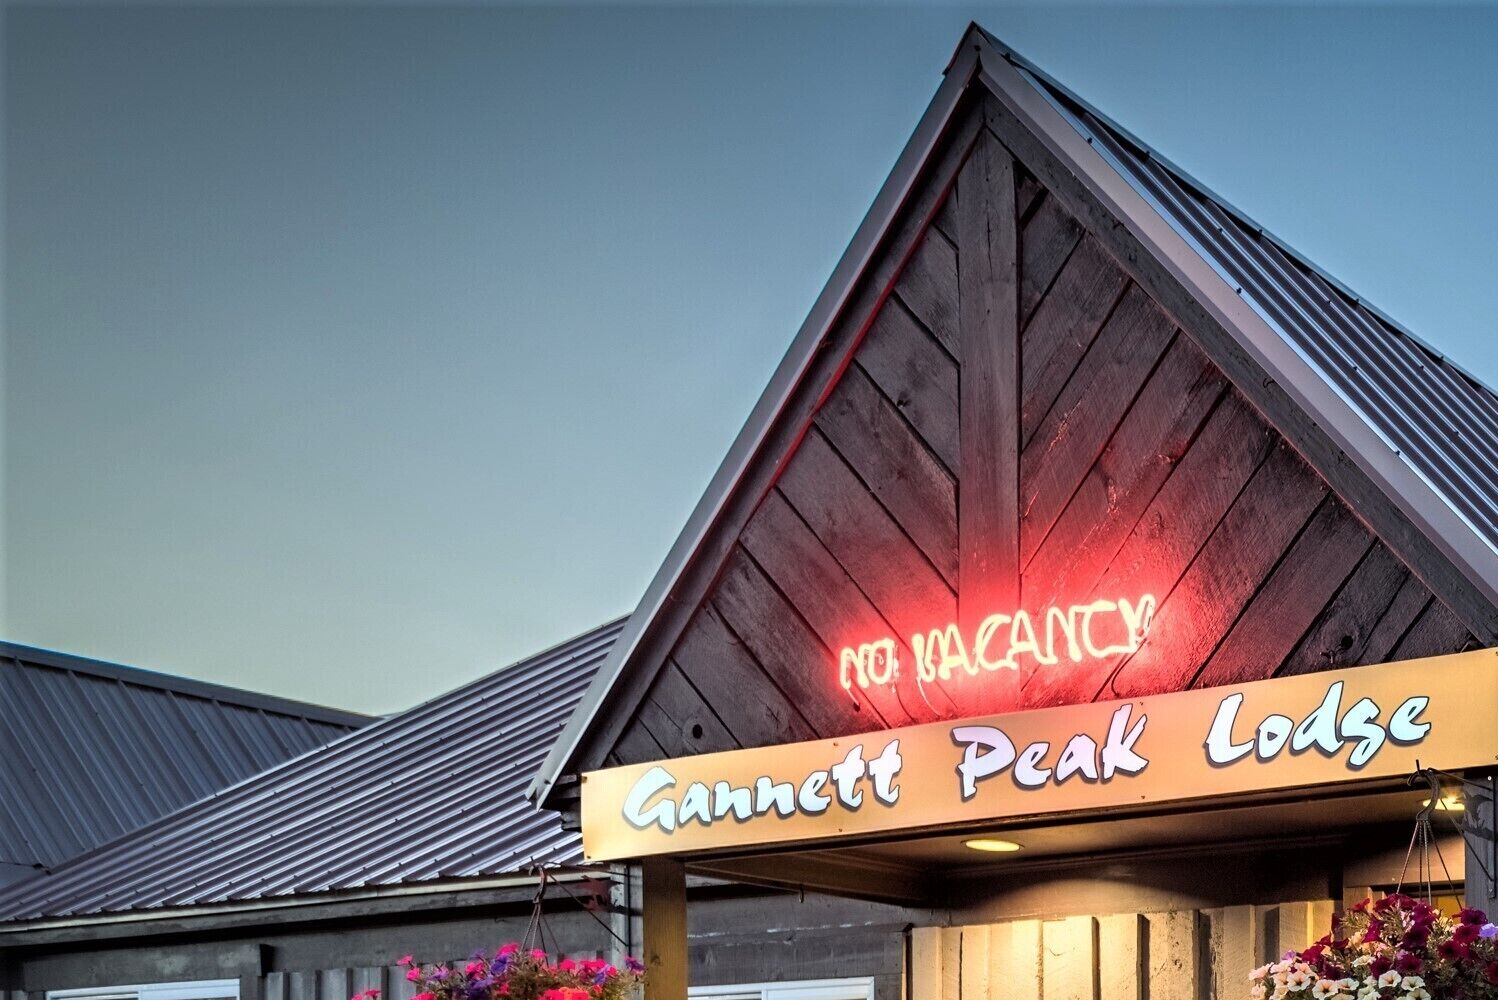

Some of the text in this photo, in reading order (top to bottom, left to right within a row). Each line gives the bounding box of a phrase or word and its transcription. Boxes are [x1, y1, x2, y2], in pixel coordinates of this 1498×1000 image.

[839, 593, 1157, 689] NO VACANCY
[622, 680, 1433, 834] Gannett Peak Lodge
